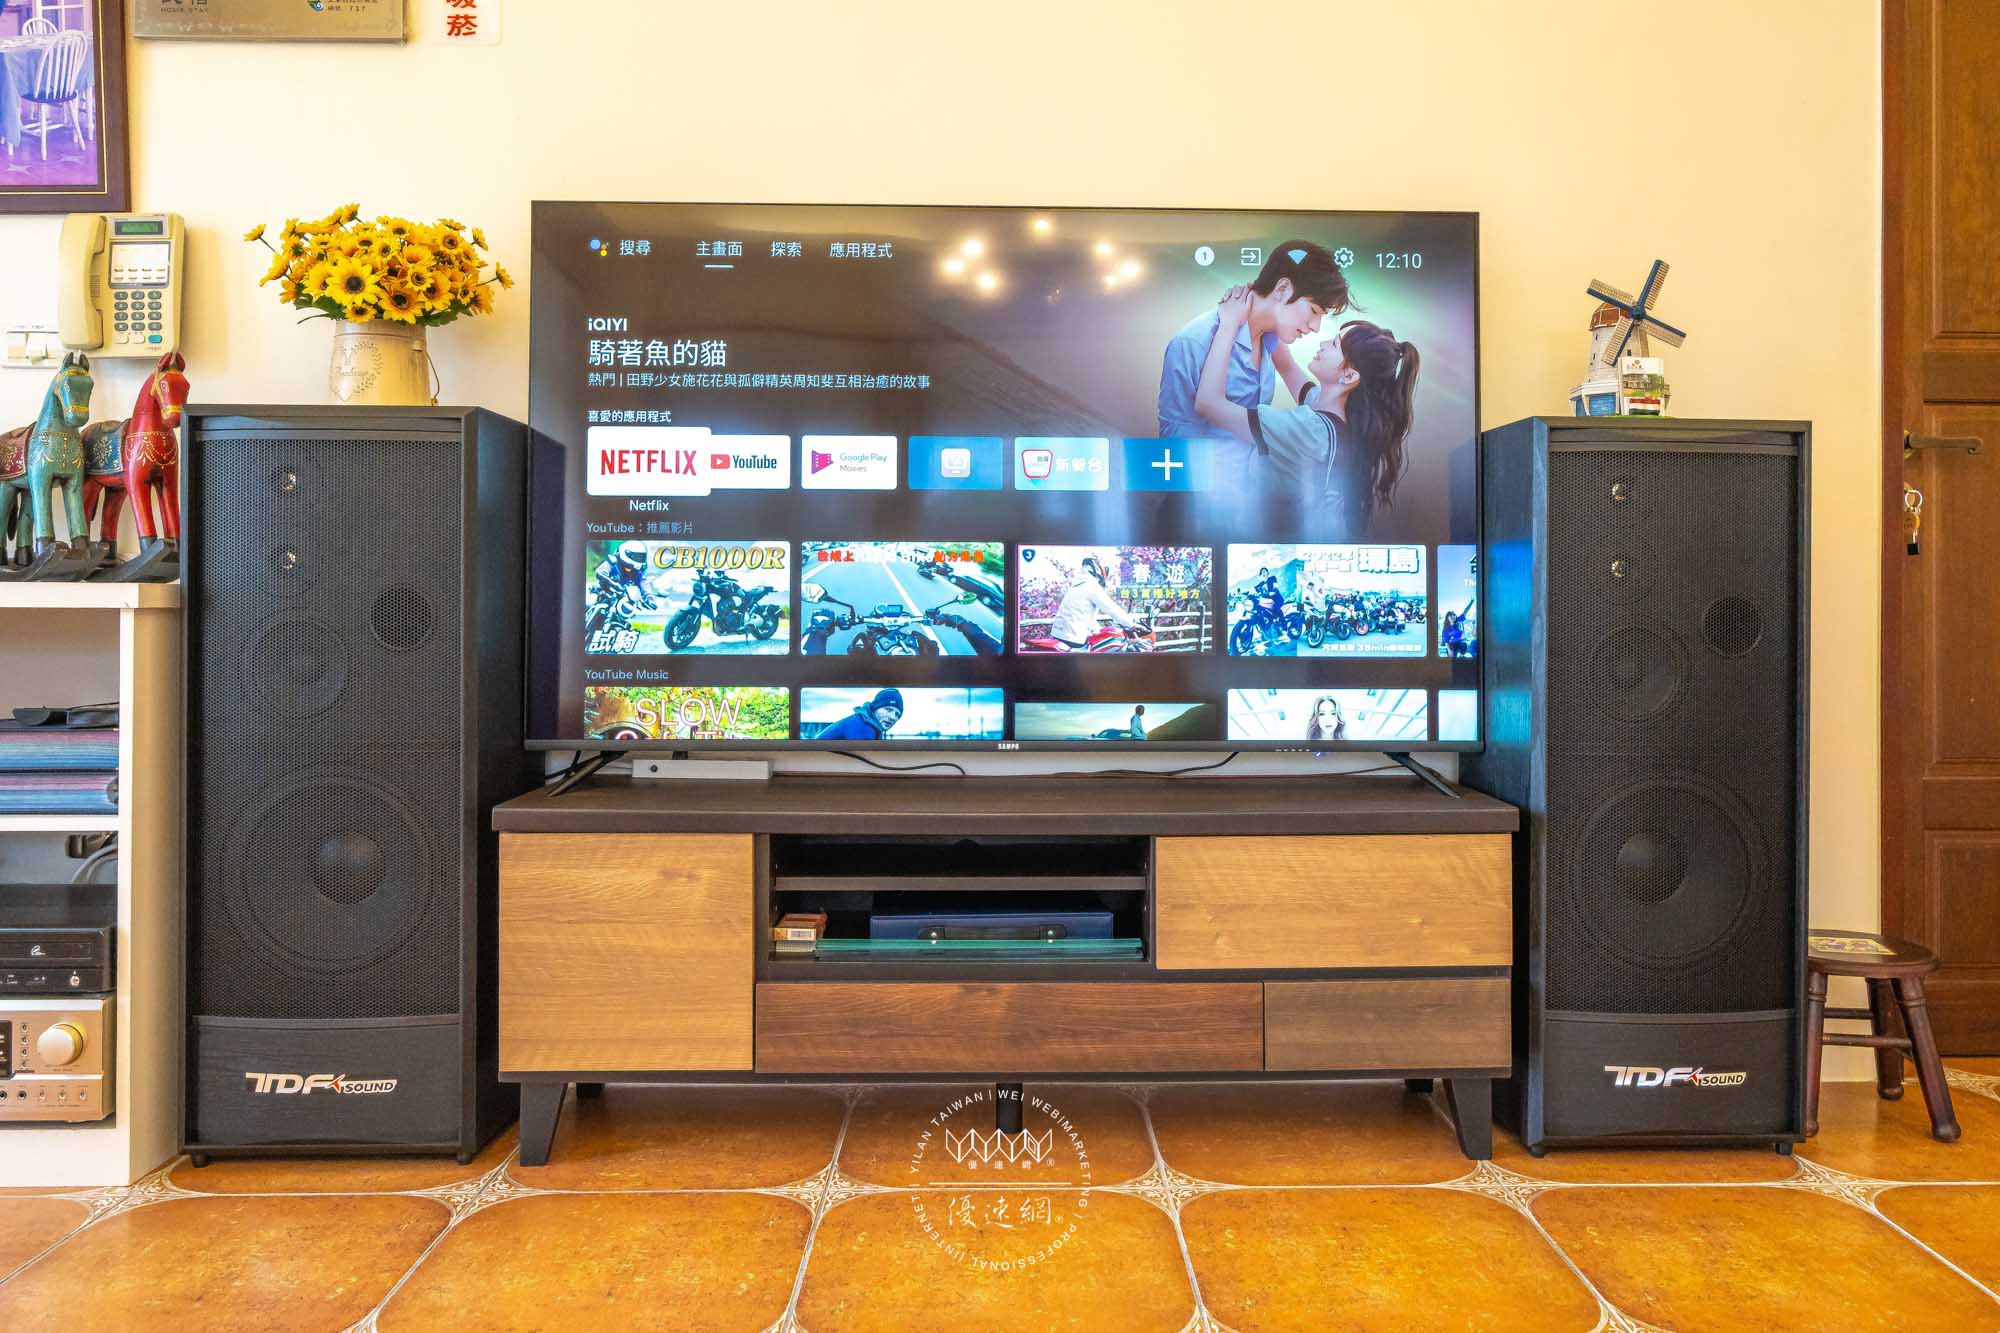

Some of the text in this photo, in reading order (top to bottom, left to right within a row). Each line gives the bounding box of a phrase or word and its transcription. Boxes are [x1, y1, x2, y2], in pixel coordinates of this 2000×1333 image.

[619, 239, 651, 256] 搜尋
[695, 240, 743, 257] 主畫面
[771, 241, 802, 258] 探索
[829, 242, 893, 259] 應用程式
[1375, 253, 1422, 269] 12:10
[587, 317, 628, 331] iQIYI
[588, 338, 727, 368] 騎著魚的貓
[587, 372, 615, 387] 熱門
[588, 410, 672, 423] 喜愛的應用程式
[600, 449, 697, 477] NETFLIX
[732, 454, 777, 470] YouTube
[839, 452, 888, 463] Google Play
[629, 500, 669, 512] Netflix
[653, 546, 785, 570] CB1000R
[588, 629, 641, 654] 試騎
[584, 669, 669, 680] YouTube Music
[635, 697, 742, 726] SLOW
[345, 1081, 395, 1093] SOUND
[1702, 1074, 1744, 1085] SOUND
